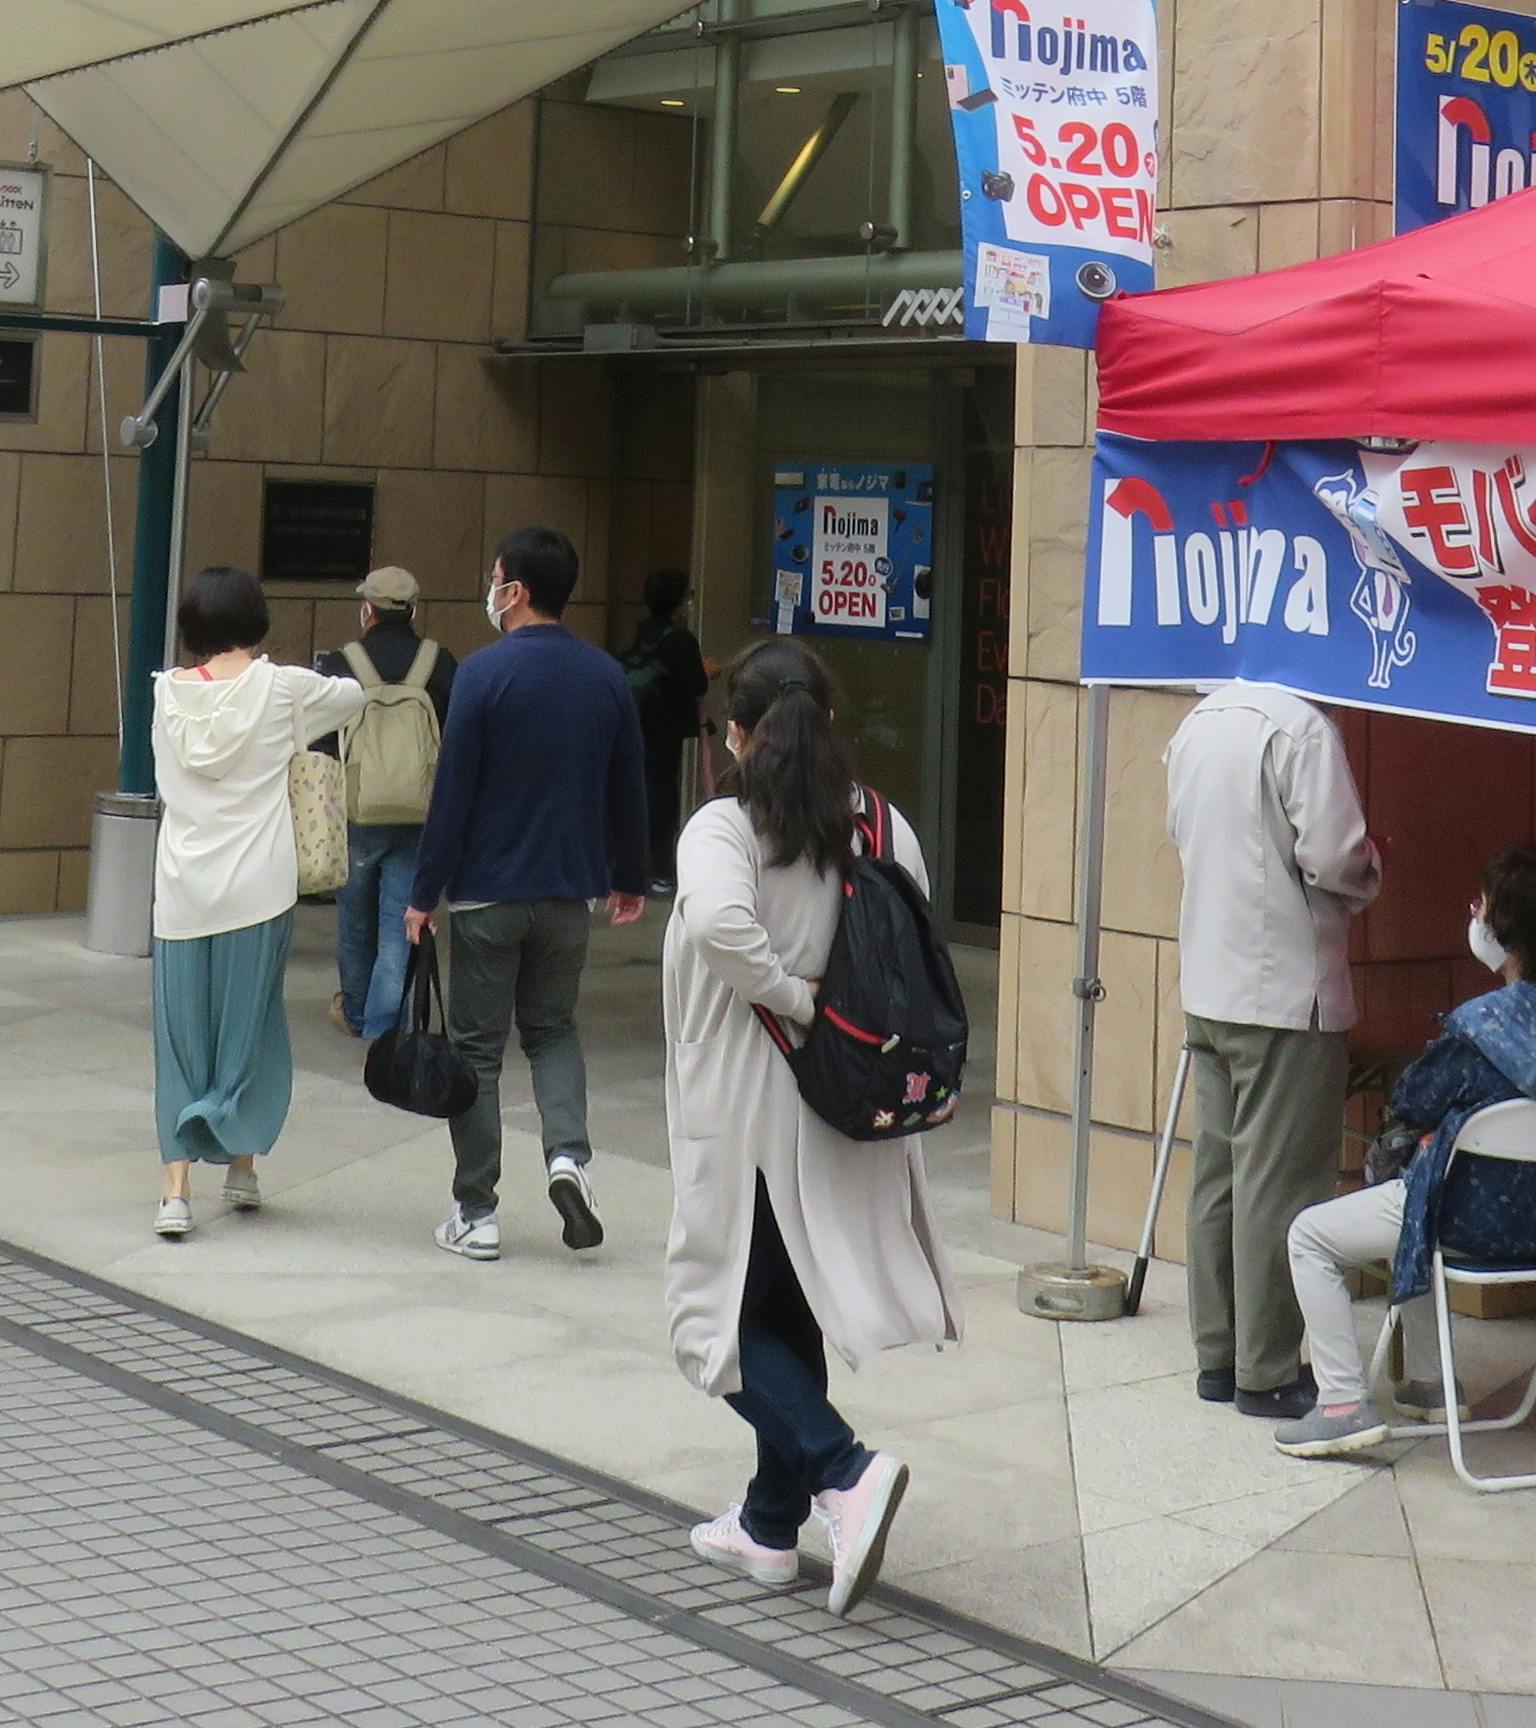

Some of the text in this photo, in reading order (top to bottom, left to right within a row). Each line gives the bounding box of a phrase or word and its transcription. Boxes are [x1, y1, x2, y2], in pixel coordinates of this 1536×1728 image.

[1001, 77, 1148, 109] ミッテン府中 5階
[1027, 172, 1155, 247] OPEN
[820, 560, 867, 587] 5.20
[819, 590, 877, 618] OPEN
